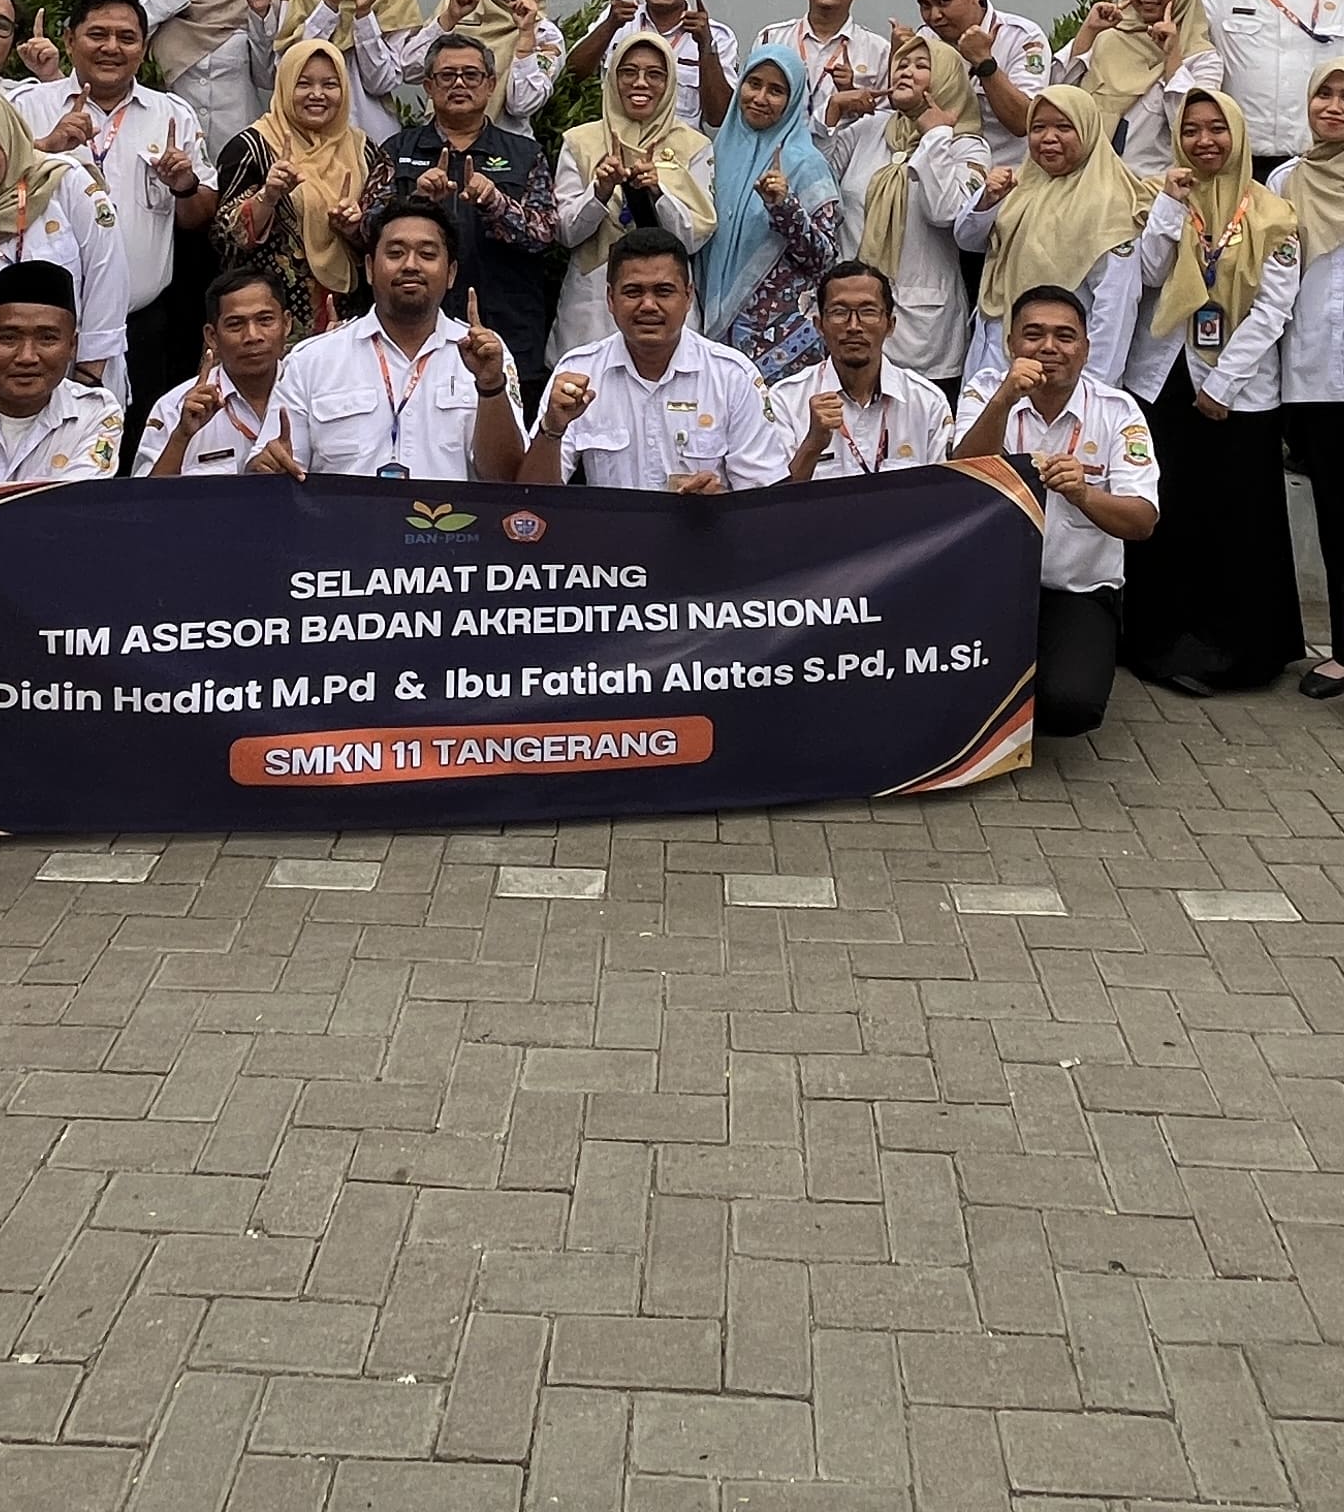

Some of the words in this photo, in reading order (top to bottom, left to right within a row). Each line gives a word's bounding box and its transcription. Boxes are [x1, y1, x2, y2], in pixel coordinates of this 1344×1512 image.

[290, 566, 478, 599] SELAMAT
[486, 564, 647, 592] DATANG
[38, 626, 111, 656] TIM
[120, 617, 290, 655] ASESOR
[301, 610, 442, 643] BADAN
[451, 603, 678, 637] AKREDITASI
[687, 597, 882, 630] NASIONAL
[113, 679, 262, 714] Hadiat
[272, 671, 376, 708] M.Pd
[394, 670, 427, 700] &
[445, 667, 511, 699] Ibu
[521, 661, 652, 697] Fatiah
[662, 660, 794, 692] Alatas
[803, 649, 895, 683] S.Pd,
[905, 639, 989, 674] M.Si.
[265, 742, 382, 775] SMKN
[391, 740, 421, 769] 11
[432, 730, 677, 765] TANGERANG
